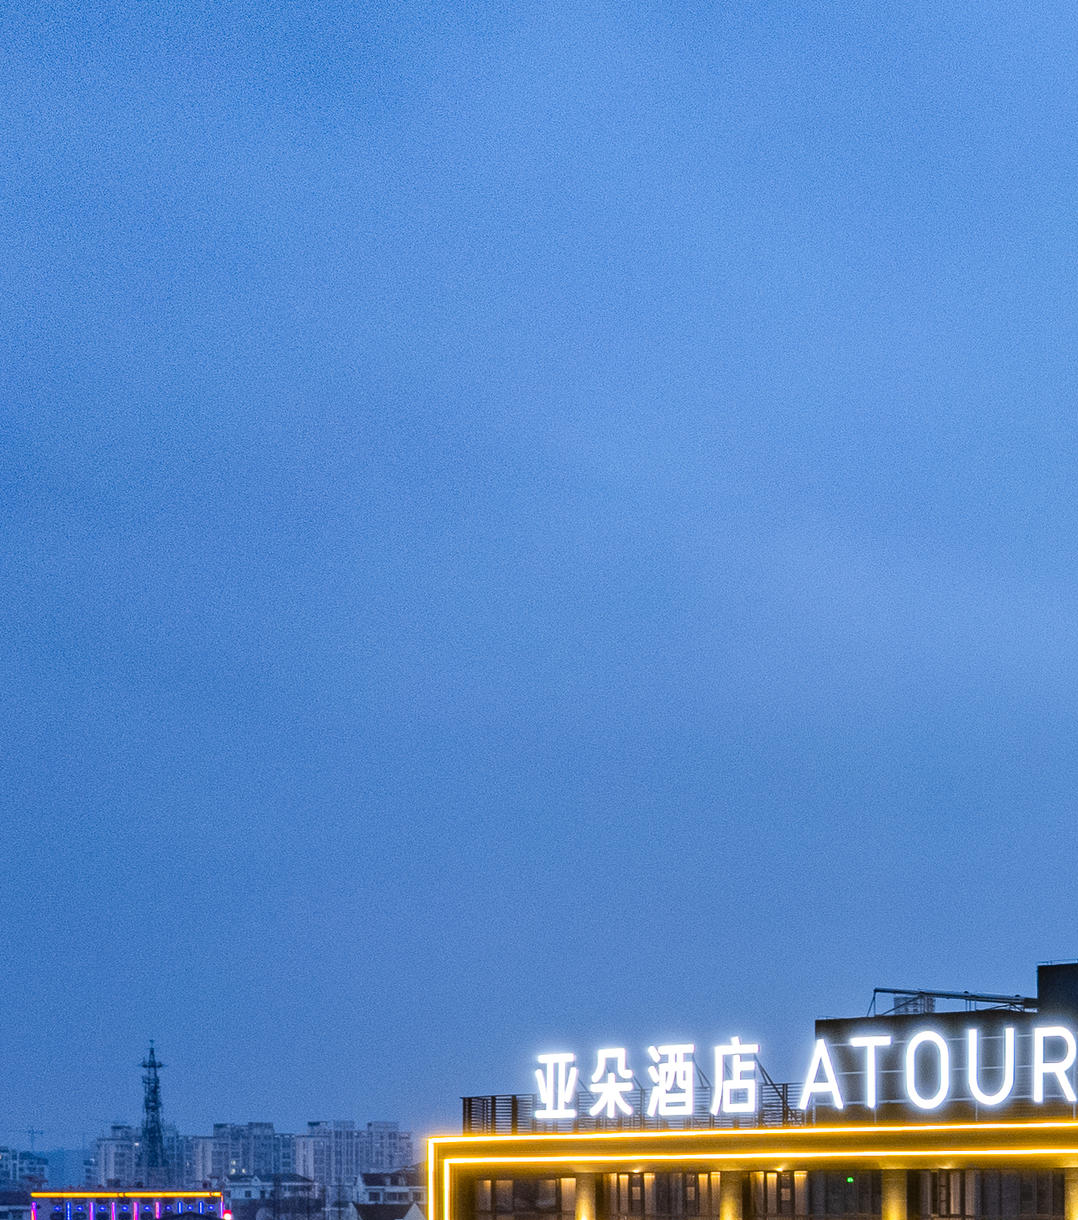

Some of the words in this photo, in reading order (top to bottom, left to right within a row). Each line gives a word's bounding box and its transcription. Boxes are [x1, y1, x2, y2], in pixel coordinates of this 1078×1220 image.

[534, 1035, 760, 1120] 亚朵酒店
[799, 1026, 1078, 1111] ATOUR
